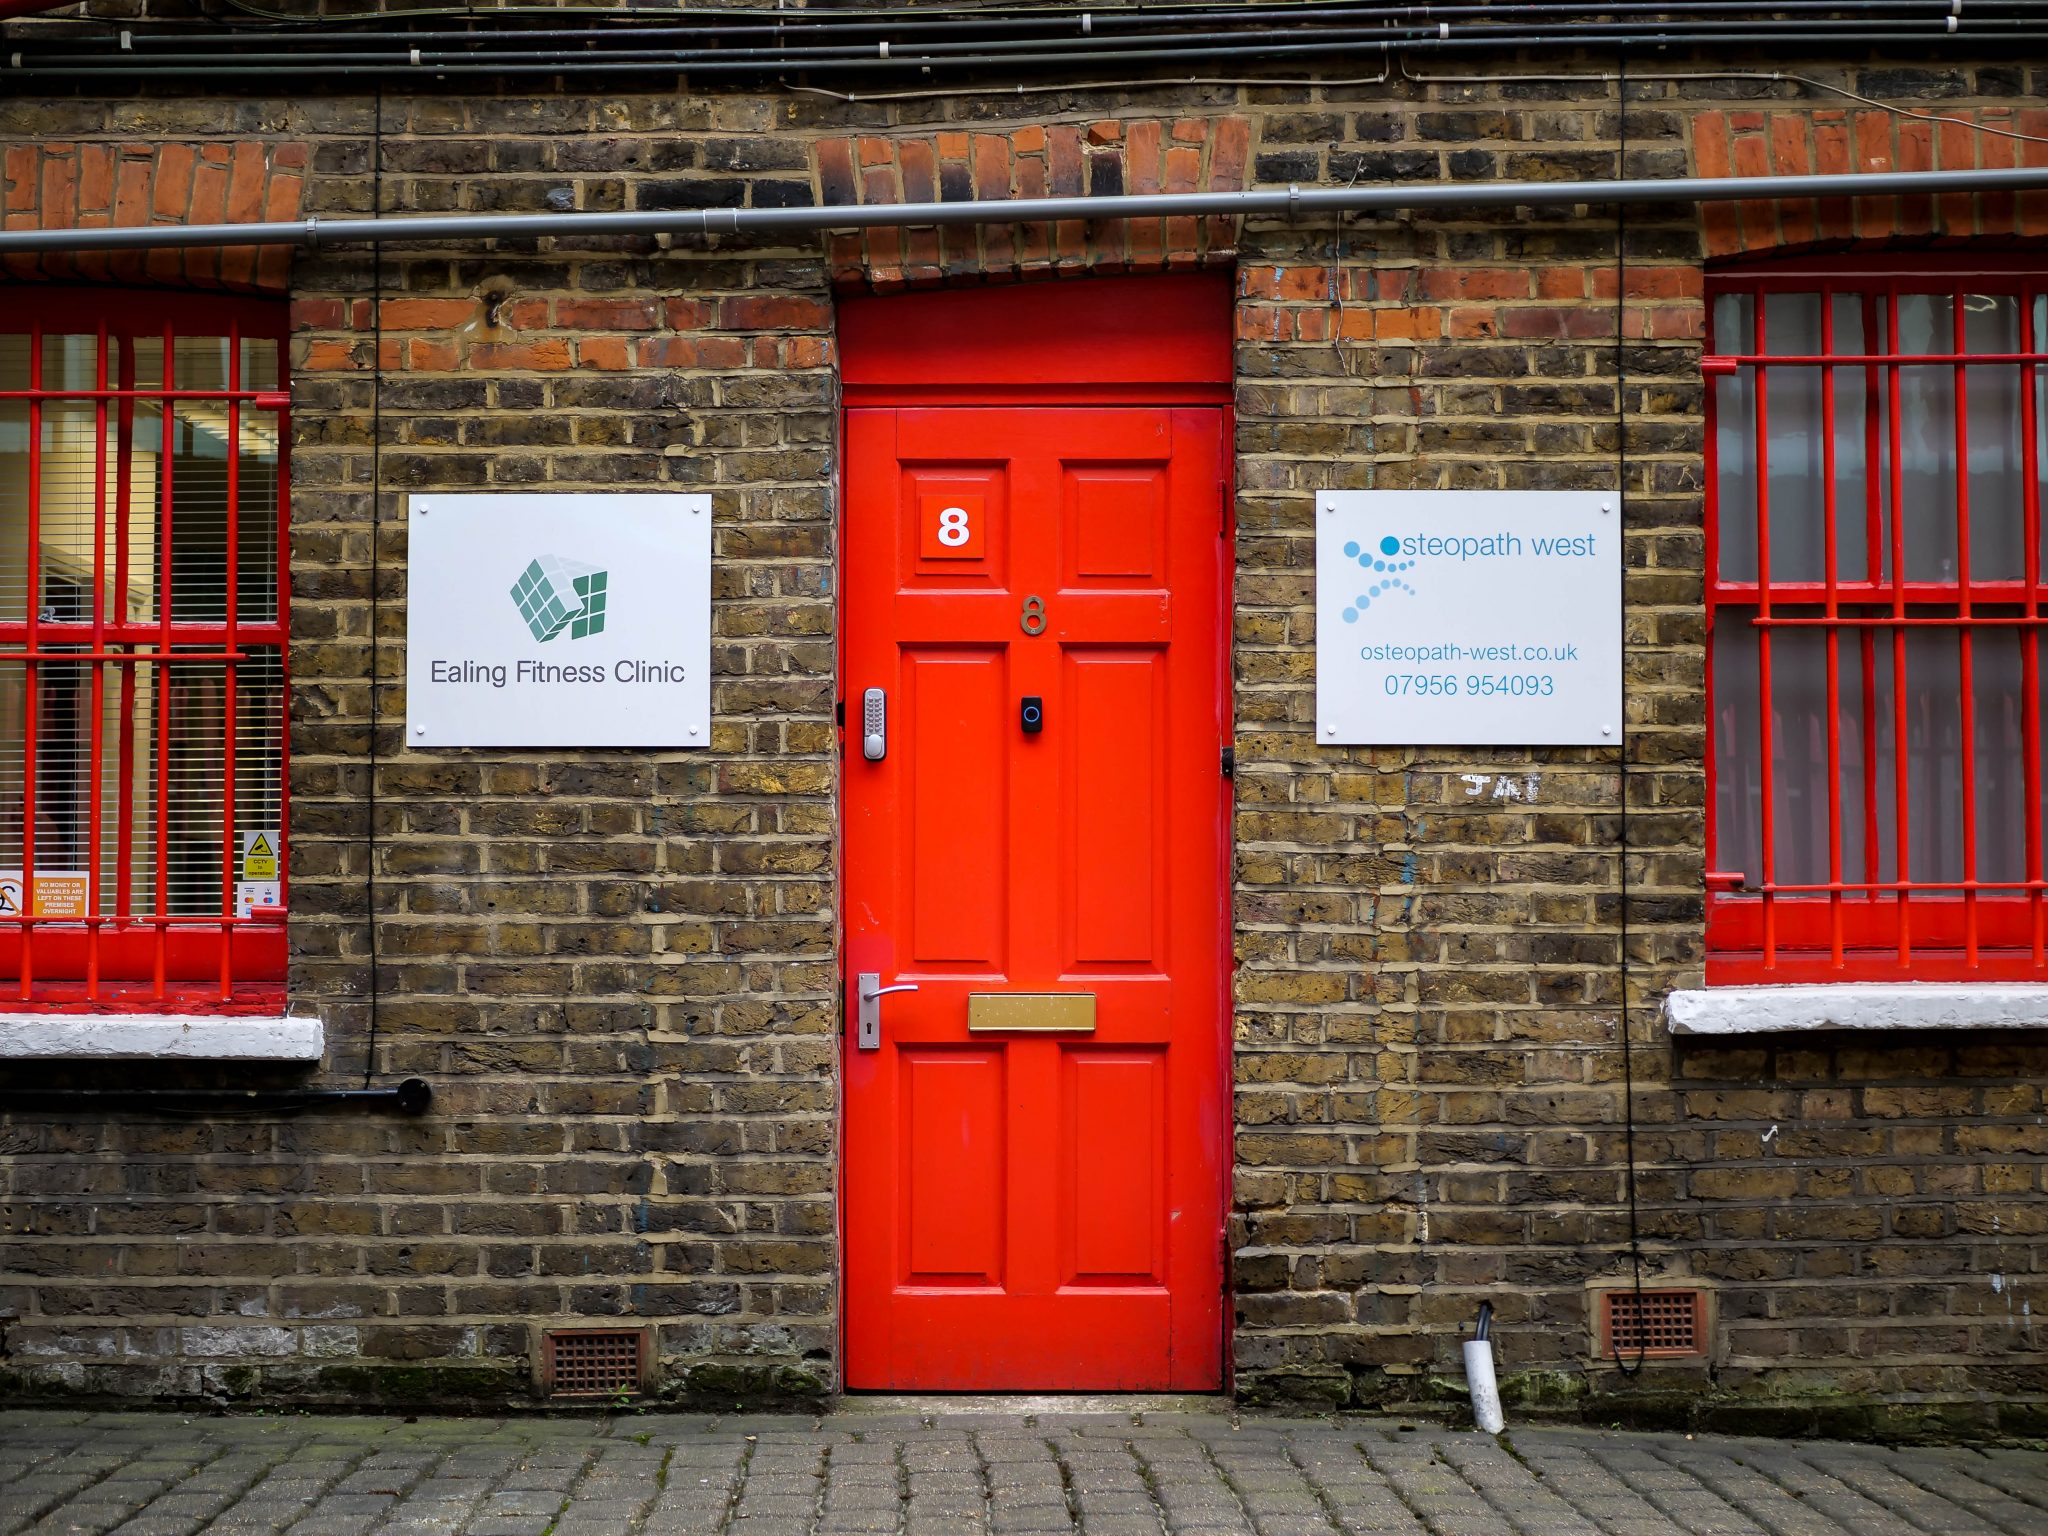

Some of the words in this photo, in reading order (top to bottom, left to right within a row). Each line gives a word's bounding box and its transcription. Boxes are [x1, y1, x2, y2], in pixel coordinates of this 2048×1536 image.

[937, 507, 970, 547] 8
[1532, 534, 1596, 556] west
[1020, 595, 1047, 636] 8
[1360, 642, 1578, 665] osteopath-west.co.uk
[431, 660, 507, 688] Ealing
[517, 660, 606, 683] Fitness
[614, 660, 685, 683] Clinic
[1384, 674, 1458, 696] 07956
[1466, 674, 1554, 696] 954093
